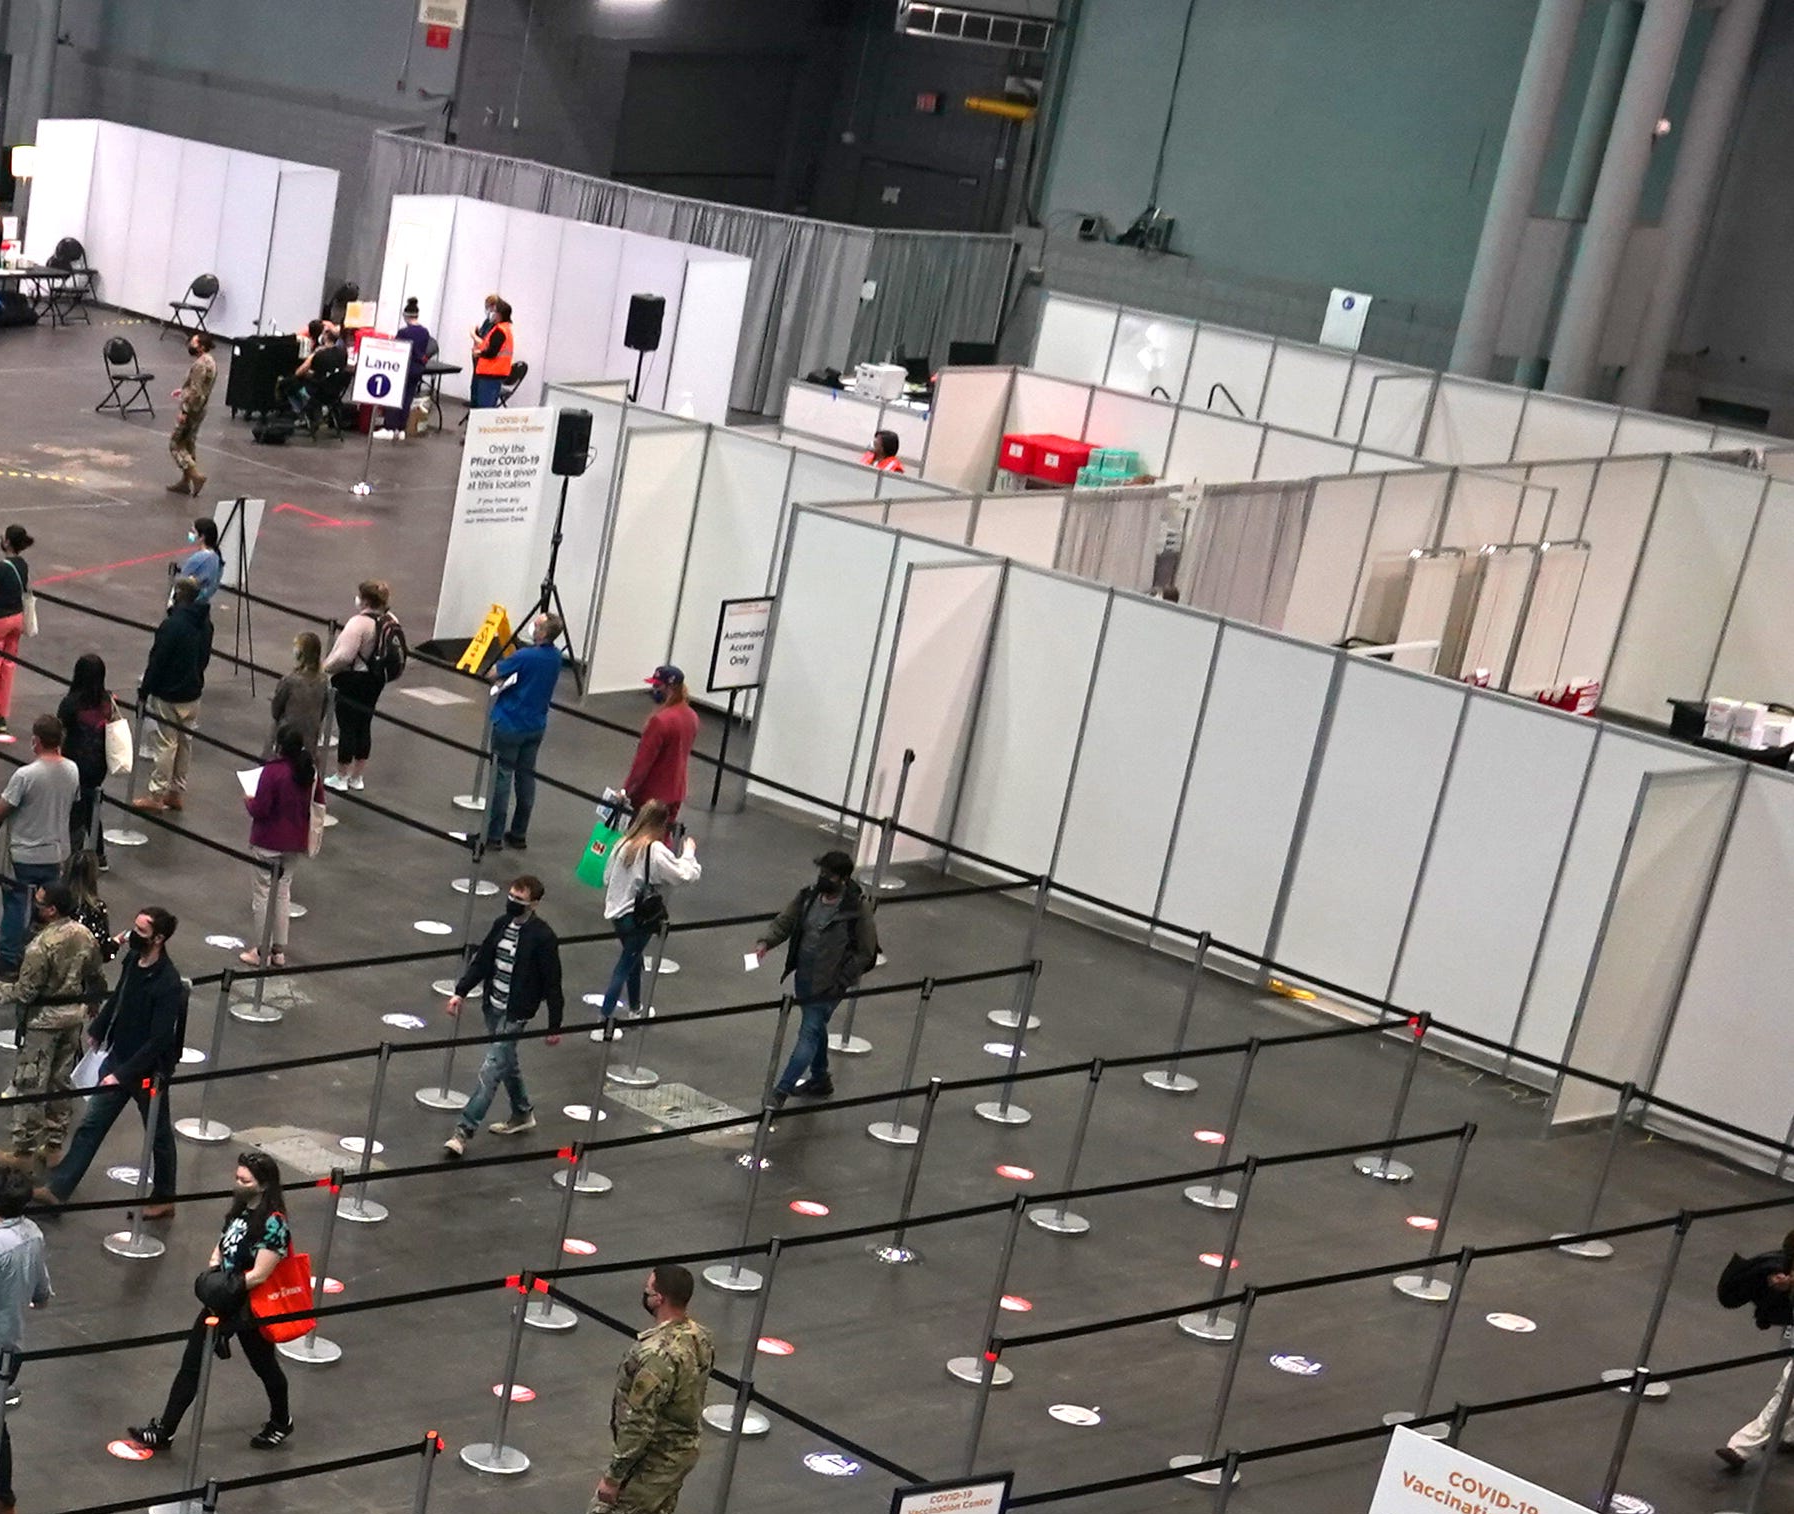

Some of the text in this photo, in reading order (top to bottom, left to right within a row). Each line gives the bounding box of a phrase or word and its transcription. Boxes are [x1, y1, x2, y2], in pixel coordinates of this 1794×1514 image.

[365, 355, 400, 373] Lane
[374, 376, 383, 395] 1
[489, 444, 526, 455] Only the
[470, 455, 540, 467] Pfizer COVID-19
[469, 468, 537, 479] vaccine is given
[466, 482, 476, 491] at
[478, 481, 493, 490] this
[724, 629, 766, 640] Authorized
[730, 644, 754, 652] Access
[729, 655, 750, 666] Only
[929, 1490, 973, 1504] COVID-19
[962, 1497, 993, 1509] Center
